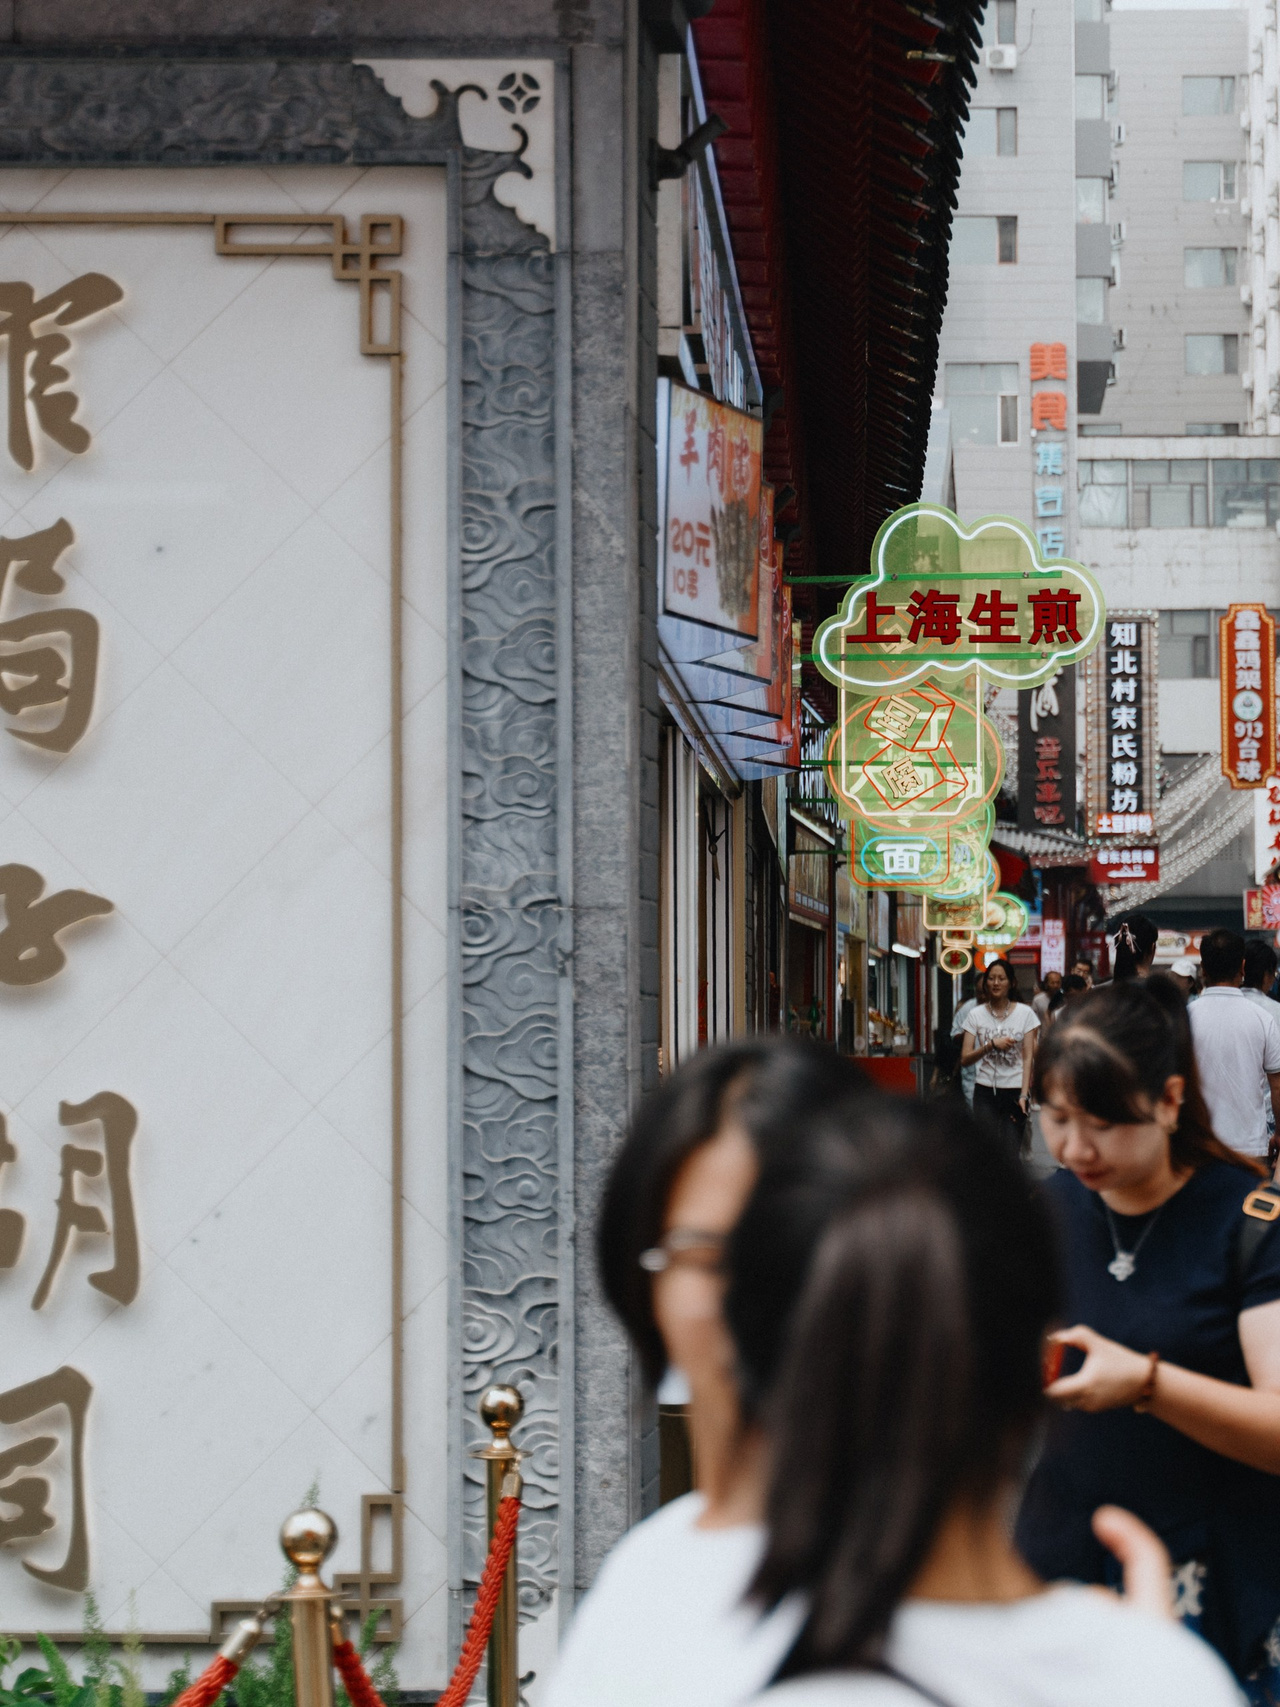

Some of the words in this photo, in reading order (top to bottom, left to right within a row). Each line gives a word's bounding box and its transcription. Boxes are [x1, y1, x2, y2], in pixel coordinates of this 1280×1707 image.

[1029, 341, 1067, 560] 美食集合店
[670, 520, 711, 569] 20元
[846, 588, 1084, 646] 上海生煎
[1109, 622, 1139, 814] 知北村宋氏粉坊
